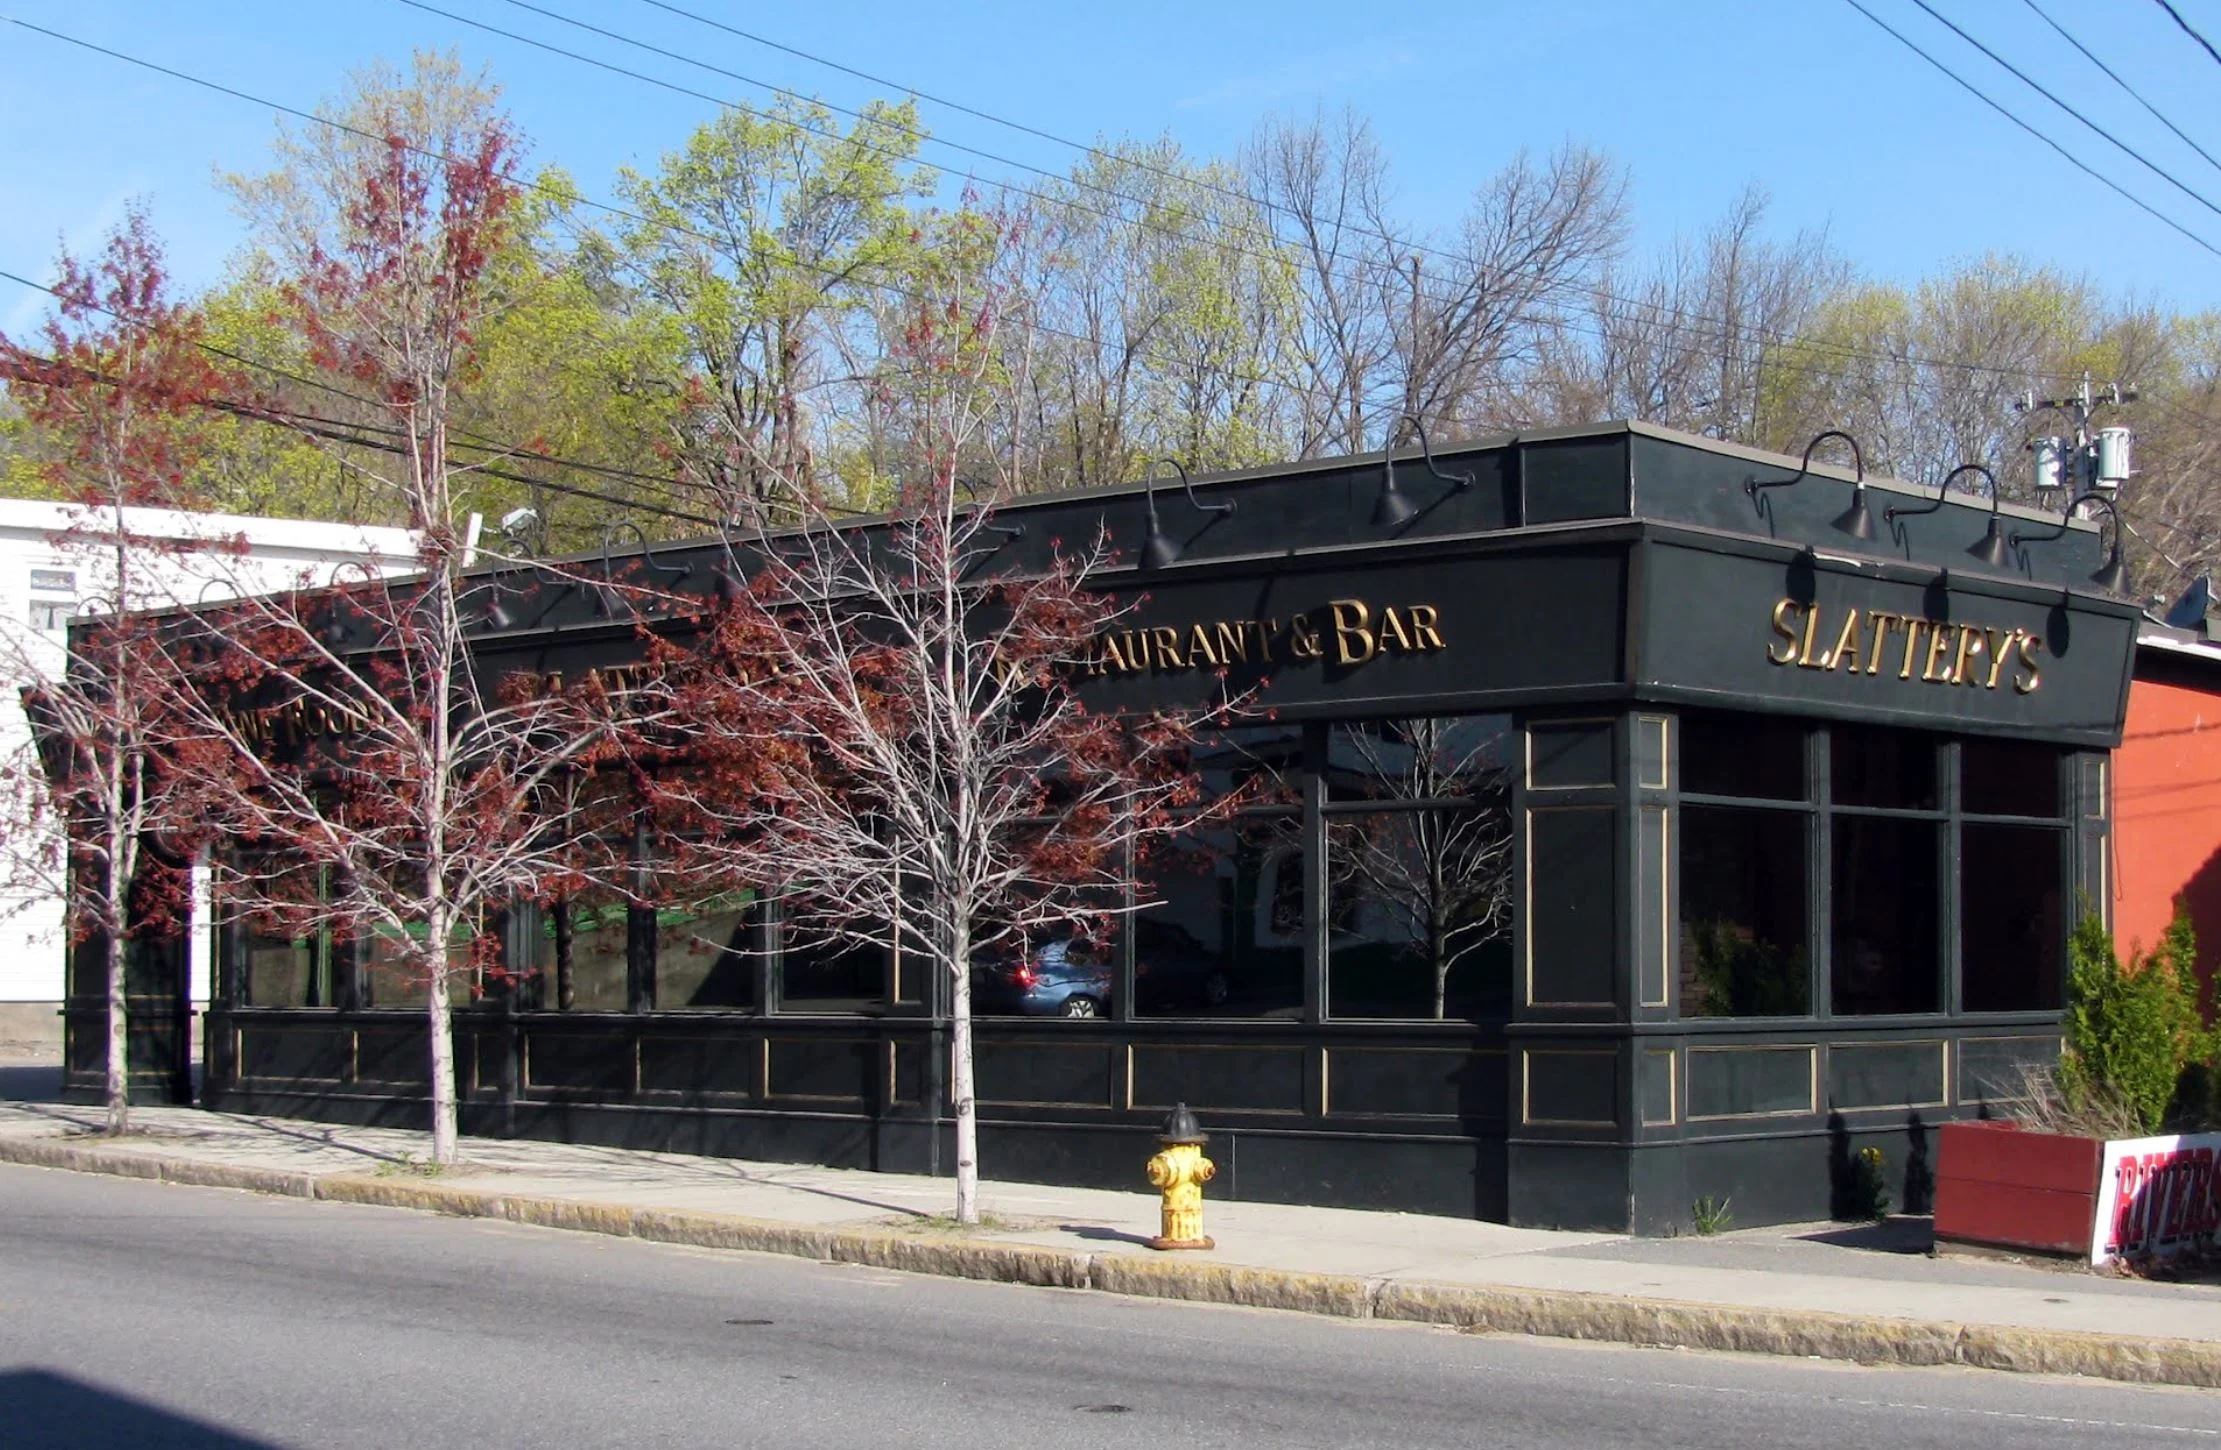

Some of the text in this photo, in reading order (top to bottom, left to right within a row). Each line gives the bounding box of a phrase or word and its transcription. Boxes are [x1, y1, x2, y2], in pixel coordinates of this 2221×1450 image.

[991, 599, 1447, 687] RAURANT & BAR
[1766, 597, 2042, 694] SLATTERY'S
[2104, 1146, 2221, 1254] RIVER
